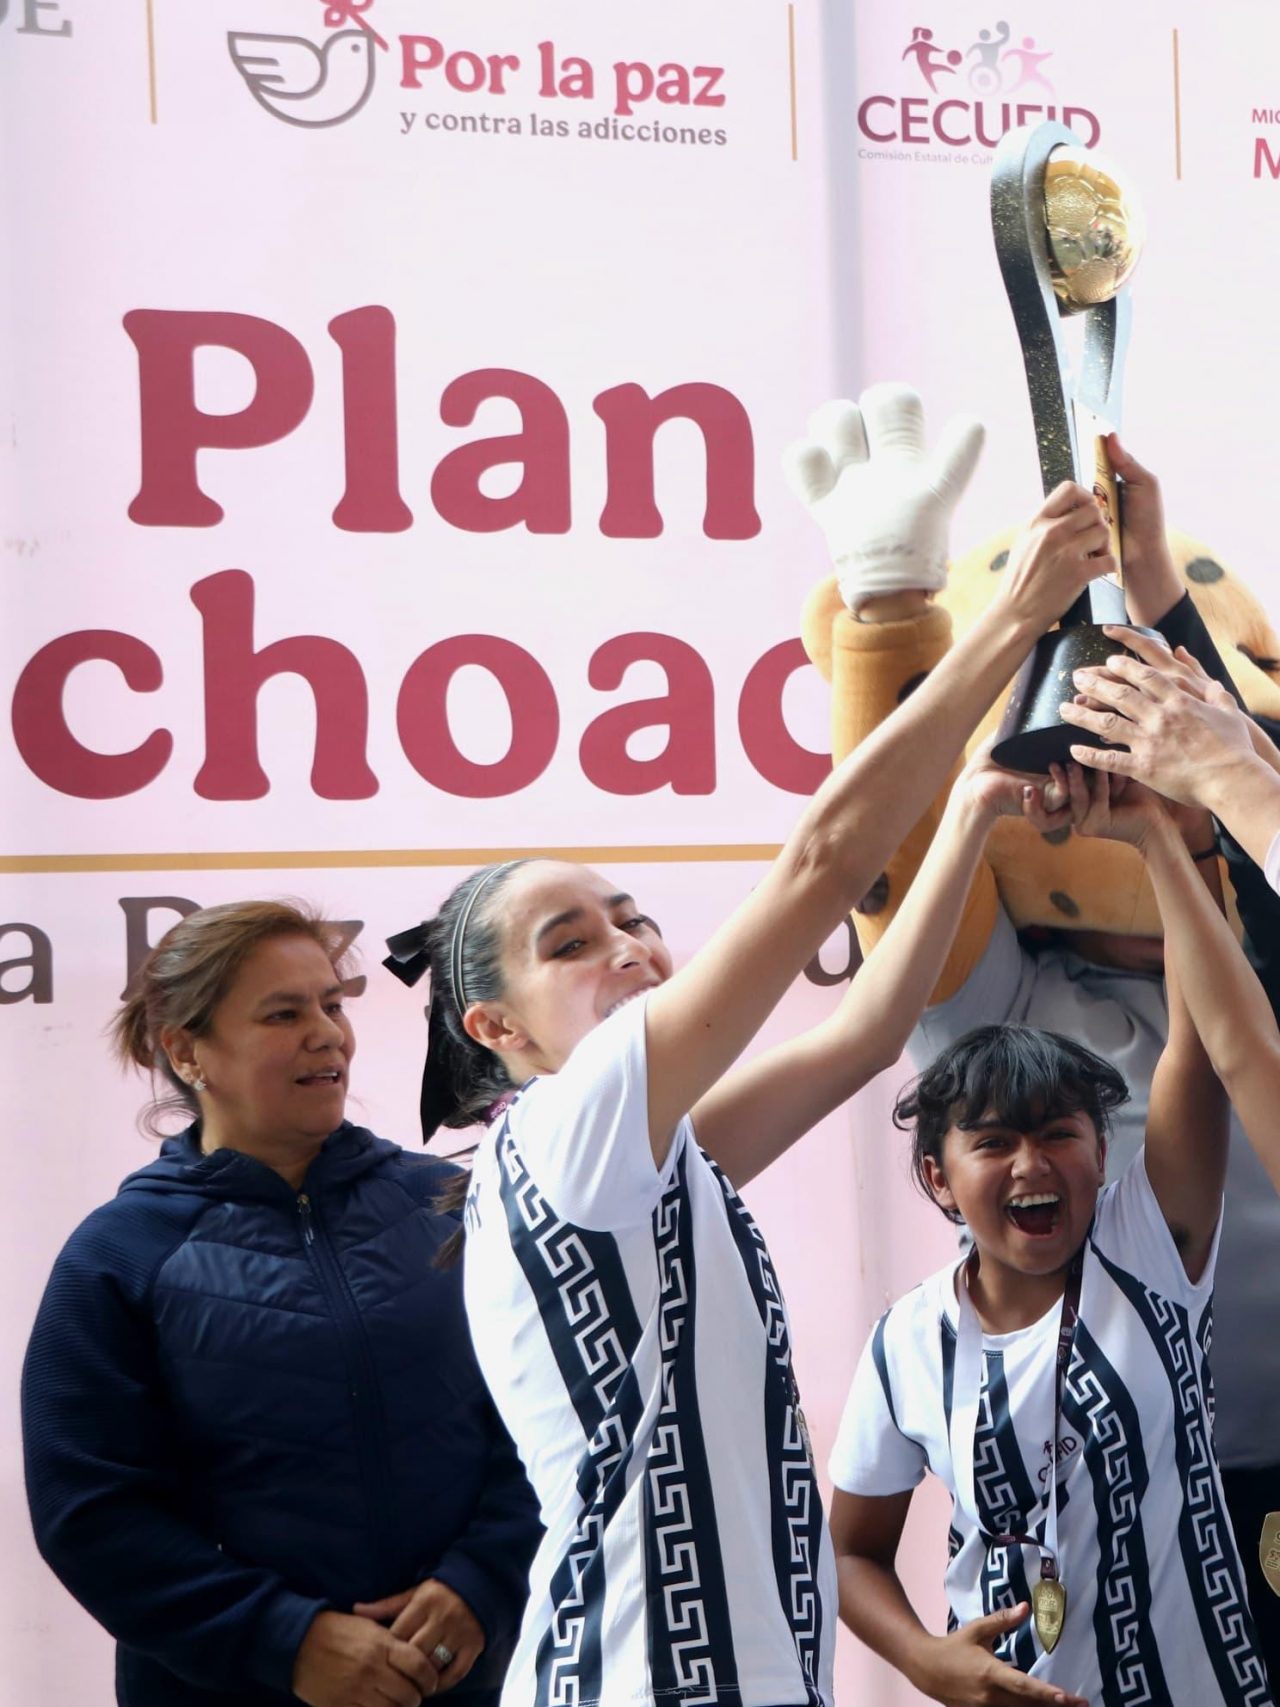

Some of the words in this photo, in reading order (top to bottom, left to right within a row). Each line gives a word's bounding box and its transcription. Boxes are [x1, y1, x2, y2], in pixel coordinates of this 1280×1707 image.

[0, 0, 72, 37] E
[399, 34, 520, 94] Por
[537, 41, 594, 99] la
[612, 62, 726, 116] paz
[400, 111, 416, 135] y
[425, 111, 521, 135] contra
[530, 113, 570, 138] las
[577, 117, 728, 146] adicciones
[857, 94, 1101, 149] CECUD
[954, 154, 969, 164] de
[123, 304, 763, 540] Plan
